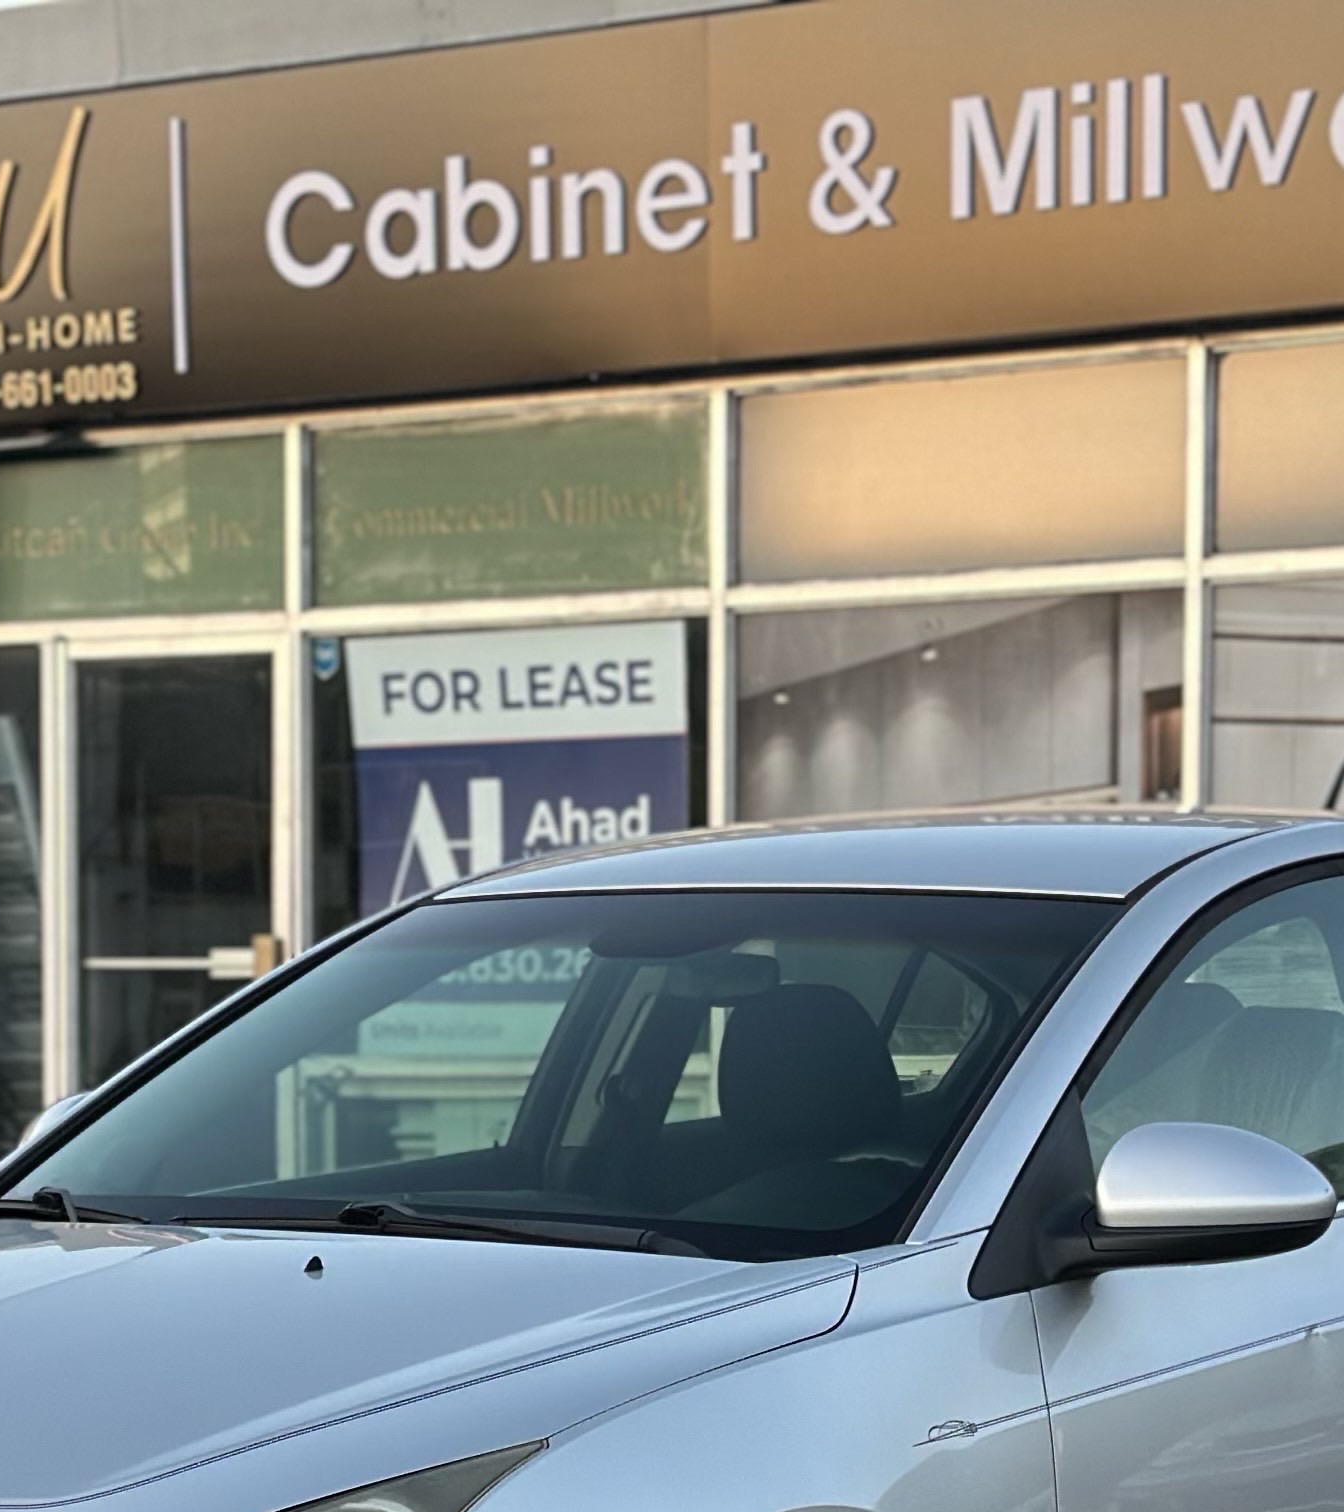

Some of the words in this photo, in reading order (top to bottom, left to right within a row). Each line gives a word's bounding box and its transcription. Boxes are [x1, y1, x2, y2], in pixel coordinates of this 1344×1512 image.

[265, 122, 764, 288] Cabinet
[808, 108, 896, 235] &
[381, 670, 482, 716] FOR
[499, 660, 655, 712] LEASE
[523, 793, 651, 846] Ahad
